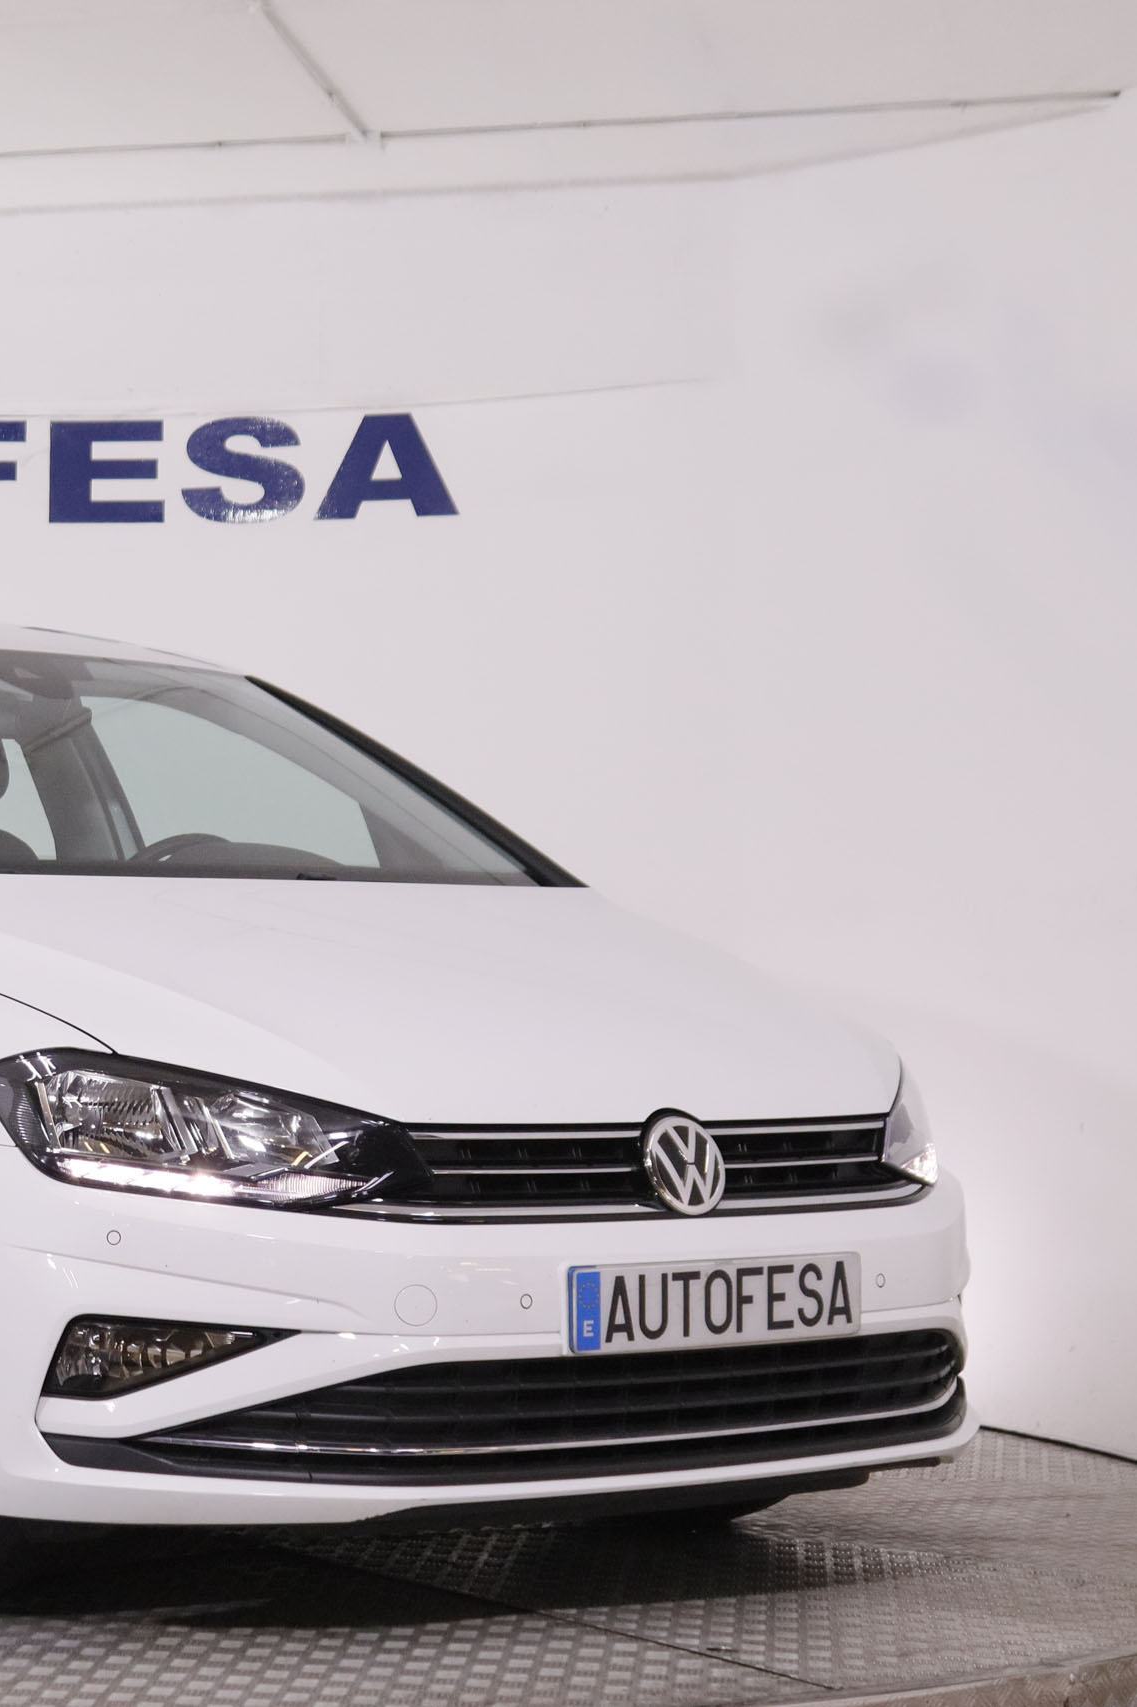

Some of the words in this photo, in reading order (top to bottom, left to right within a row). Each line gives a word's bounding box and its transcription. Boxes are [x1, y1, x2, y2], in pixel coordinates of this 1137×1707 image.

[644, 1114, 726, 1215] VW
[582, 1319, 594, 1338] E
[604, 1260, 853, 1344] AUTOFESA
